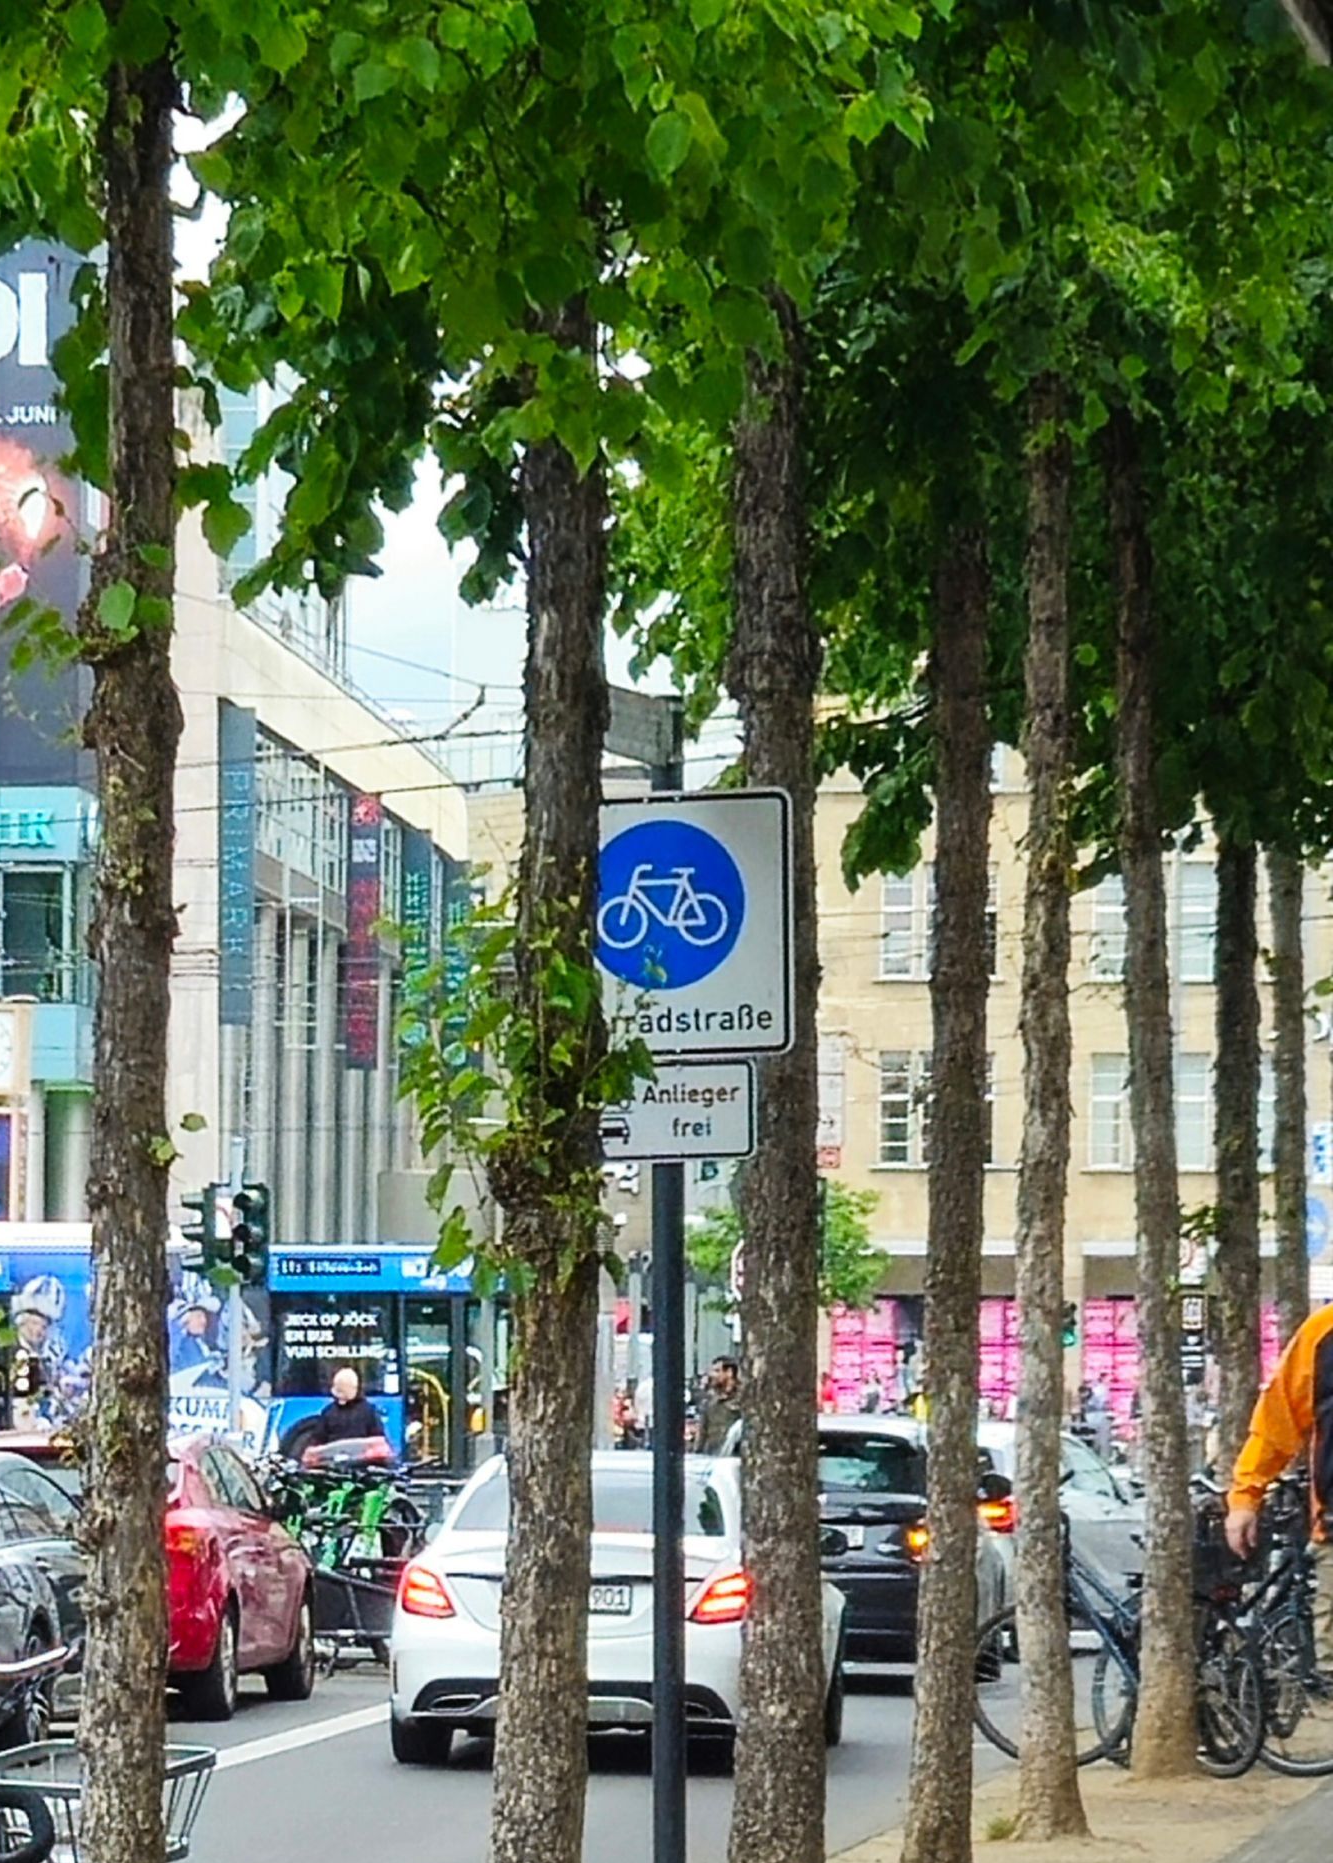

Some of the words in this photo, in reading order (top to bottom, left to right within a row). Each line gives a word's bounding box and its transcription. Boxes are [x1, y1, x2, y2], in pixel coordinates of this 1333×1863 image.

[6, 405, 56, 426] JUNI
[610, 1003, 773, 1035] rradstraße
[642, 1083, 740, 1108] Anlieger
[672, 1116, 712, 1137] frei
[592, 1588, 626, 1606] 901
